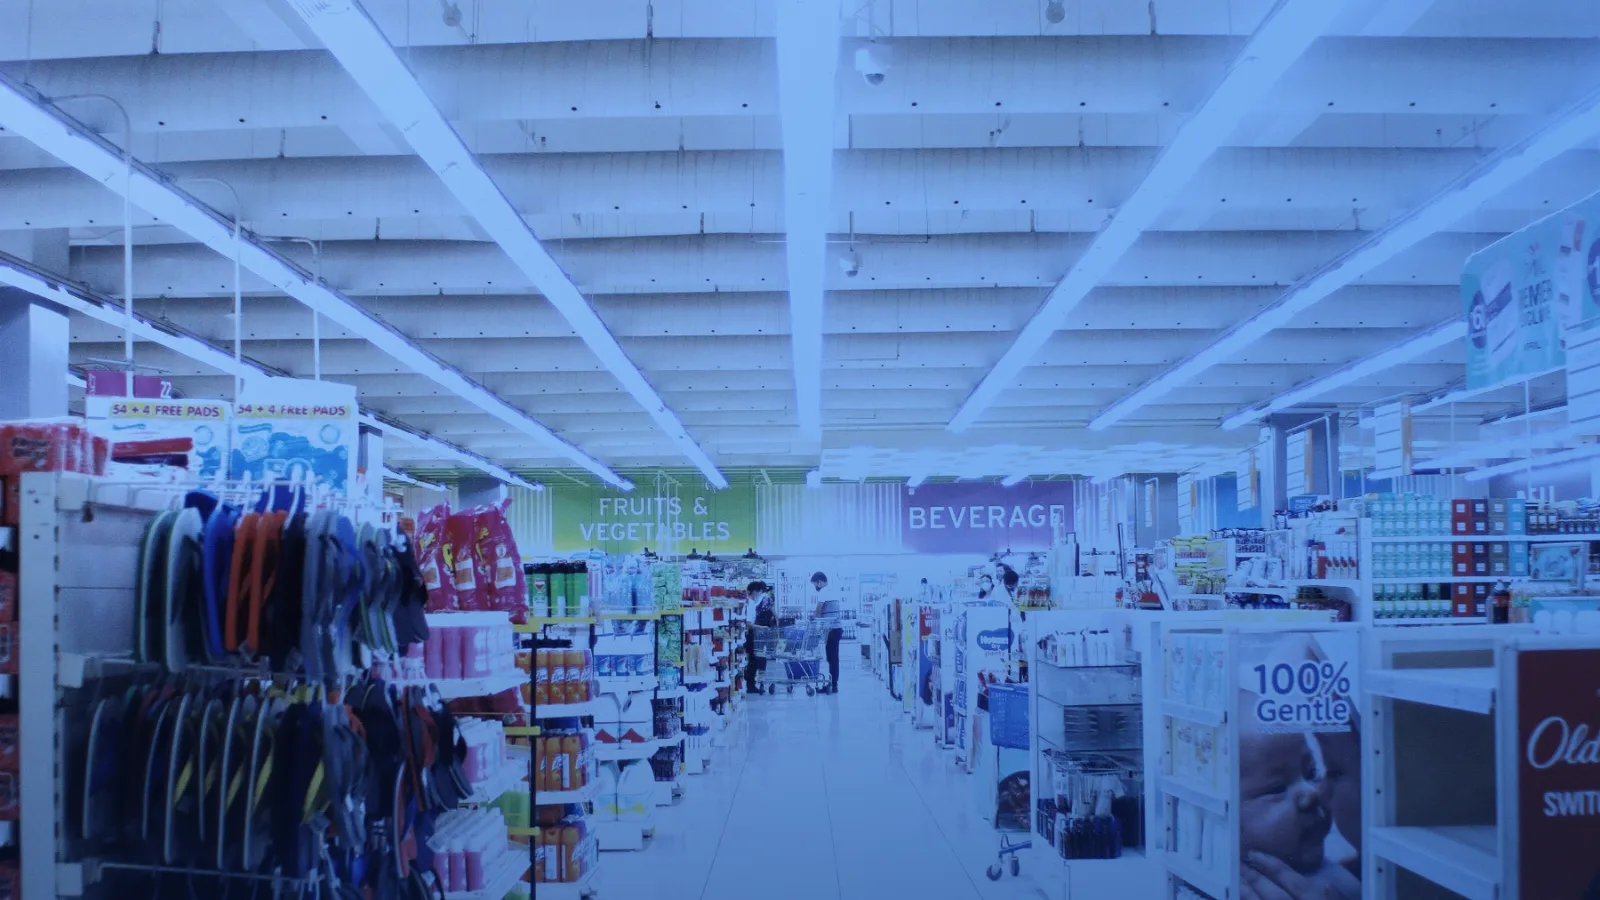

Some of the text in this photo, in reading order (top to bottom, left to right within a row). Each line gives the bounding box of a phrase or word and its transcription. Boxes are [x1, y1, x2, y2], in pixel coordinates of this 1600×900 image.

[160, 380, 172, 398] 22
[112, 404, 219, 417] 54 + 4 FREE PADS
[237, 404, 252, 415] 54
[268, 405, 275, 415] 4
[280, 405, 308, 415] FREE
[313, 405, 346, 416] PADS
[599, 496, 708, 517] FRUITS &
[580, 521, 731, 542] VEGETABLES
[1253, 661, 1350, 695] 100%
[1257, 697, 1347, 722] Gentle
[1543, 790, 1600, 817] SWIT
